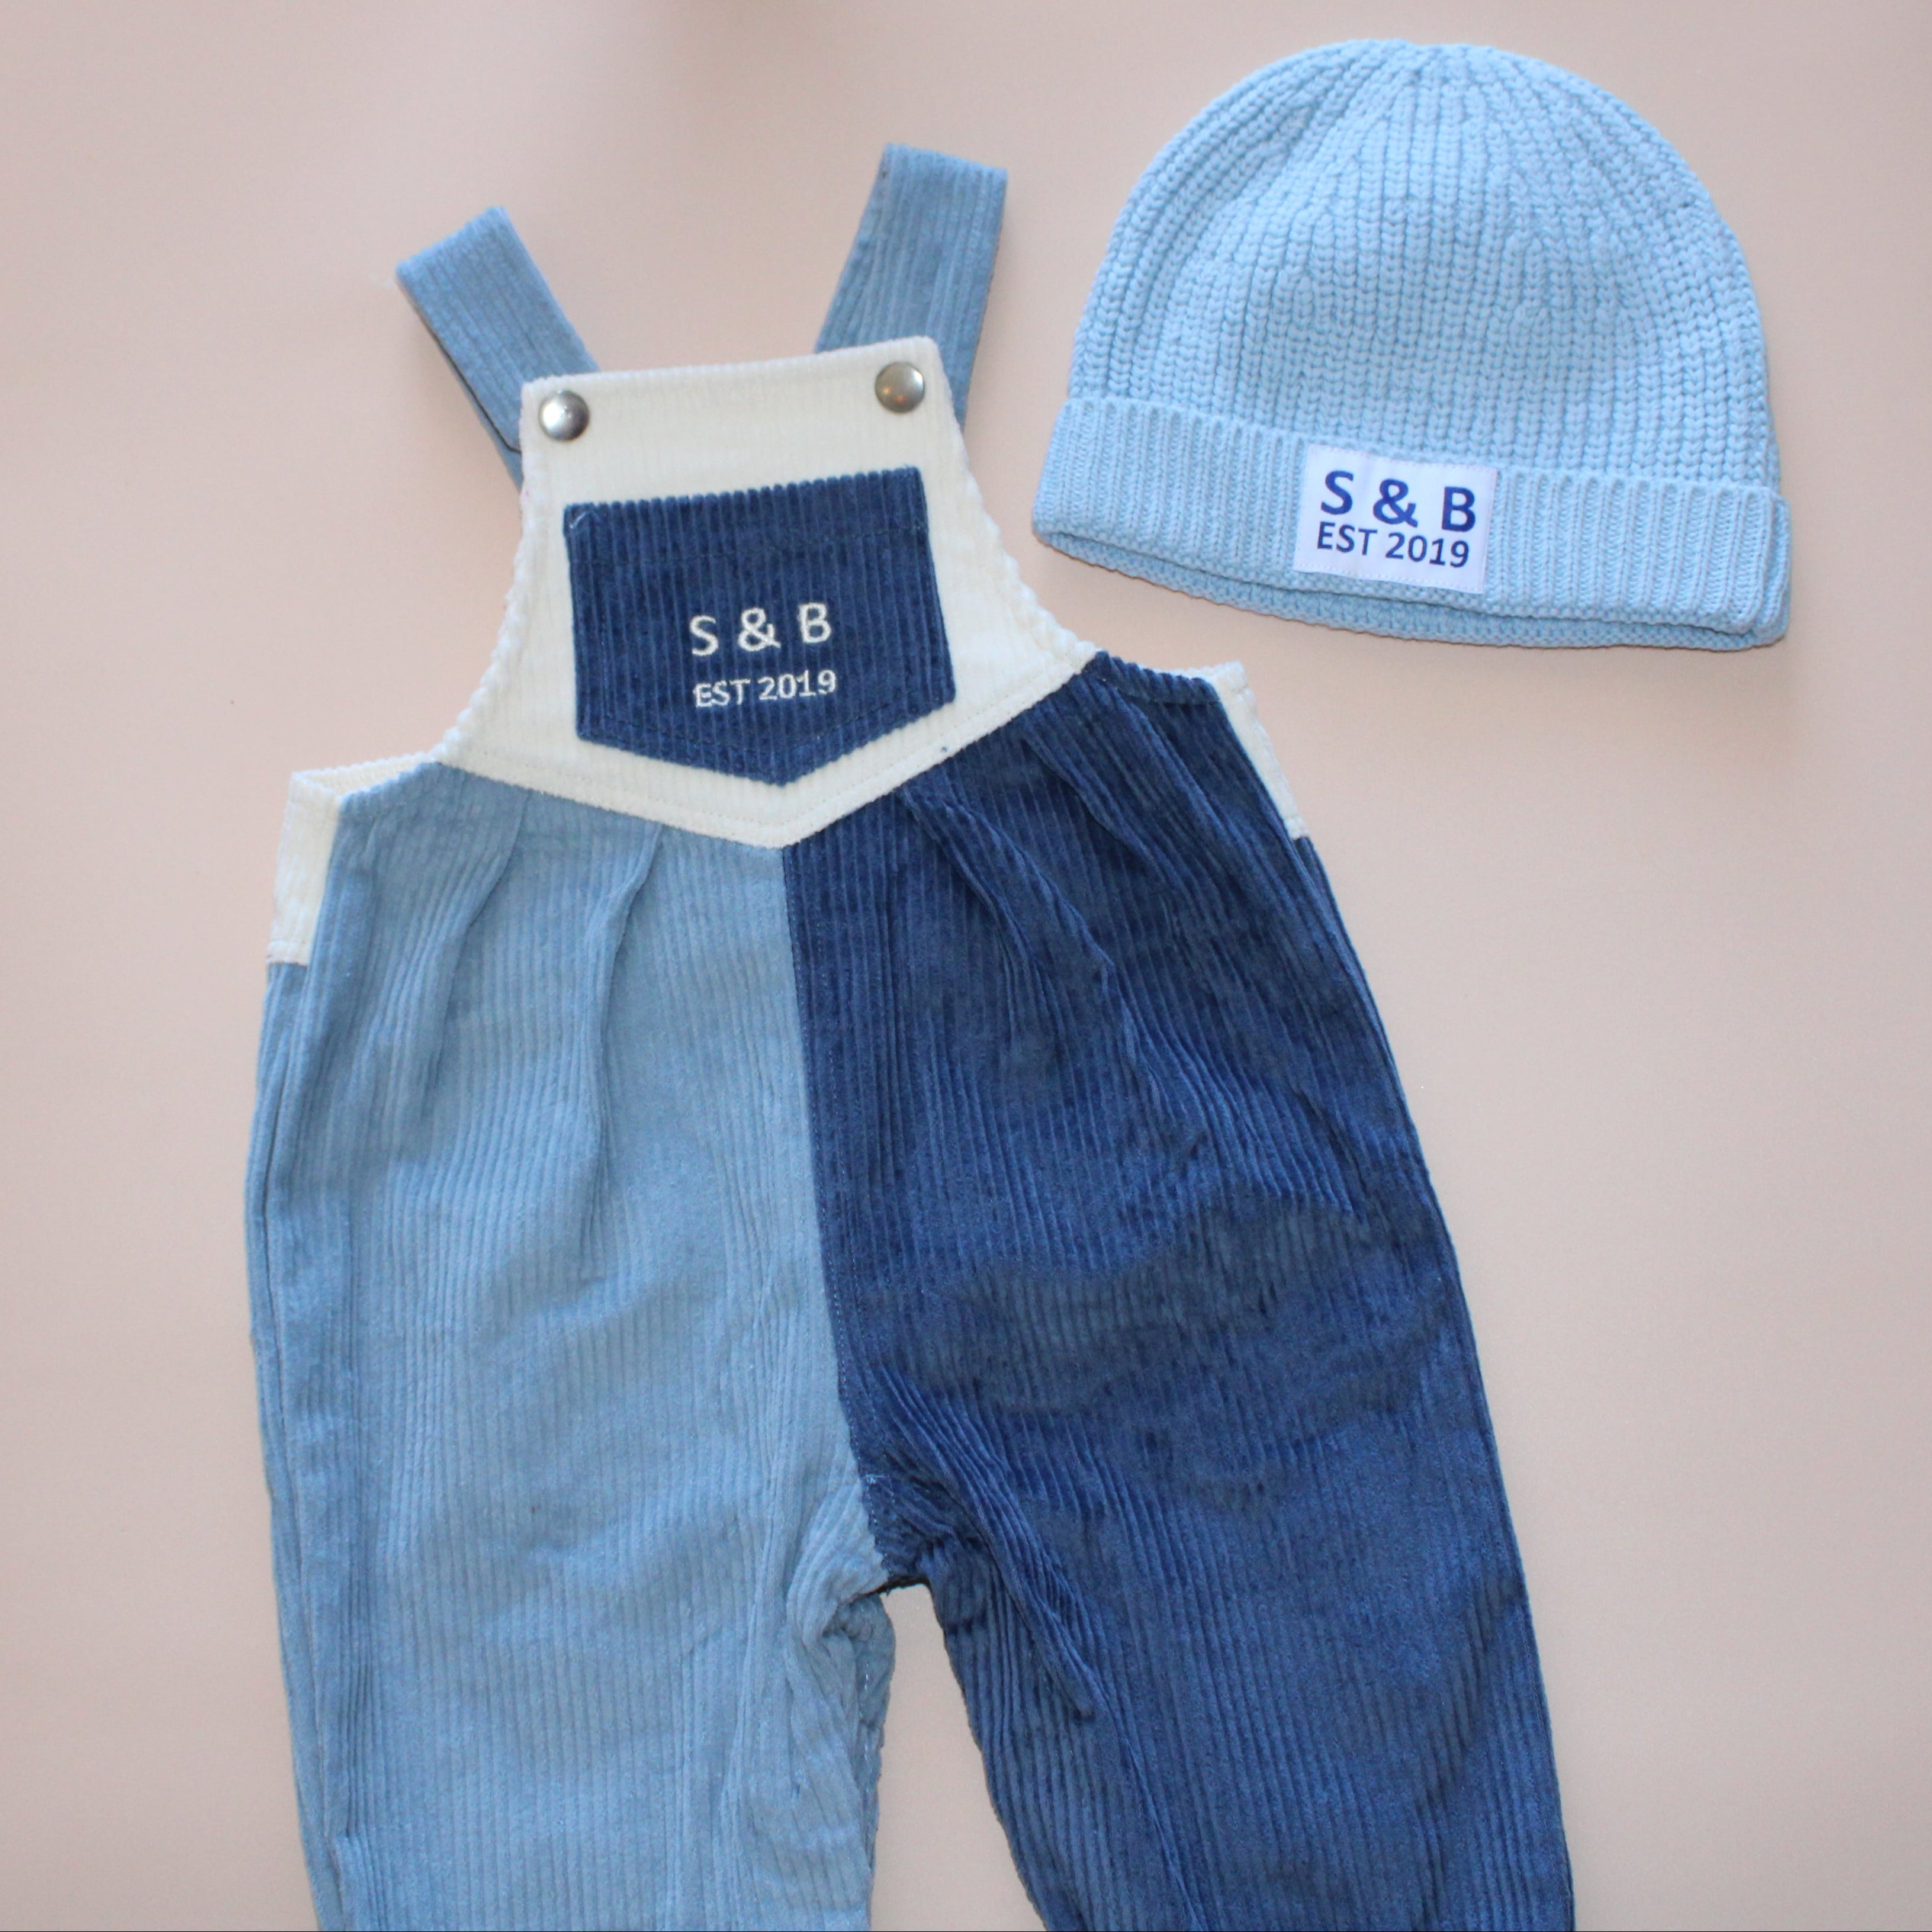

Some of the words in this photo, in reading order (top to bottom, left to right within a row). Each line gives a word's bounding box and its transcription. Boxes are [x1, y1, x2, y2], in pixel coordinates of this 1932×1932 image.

[1320, 470, 1354, 515] S
[1372, 478, 1419, 528] &
[1441, 486, 1476, 533] B
[1317, 521, 1378, 556] EST
[1385, 532, 1470, 568] 2019
[689, 615, 719, 657] S
[738, 607, 782, 652] &
[797, 602, 832, 644] B
[693, 679, 751, 708] EST
[757, 669, 838, 701] 2019
